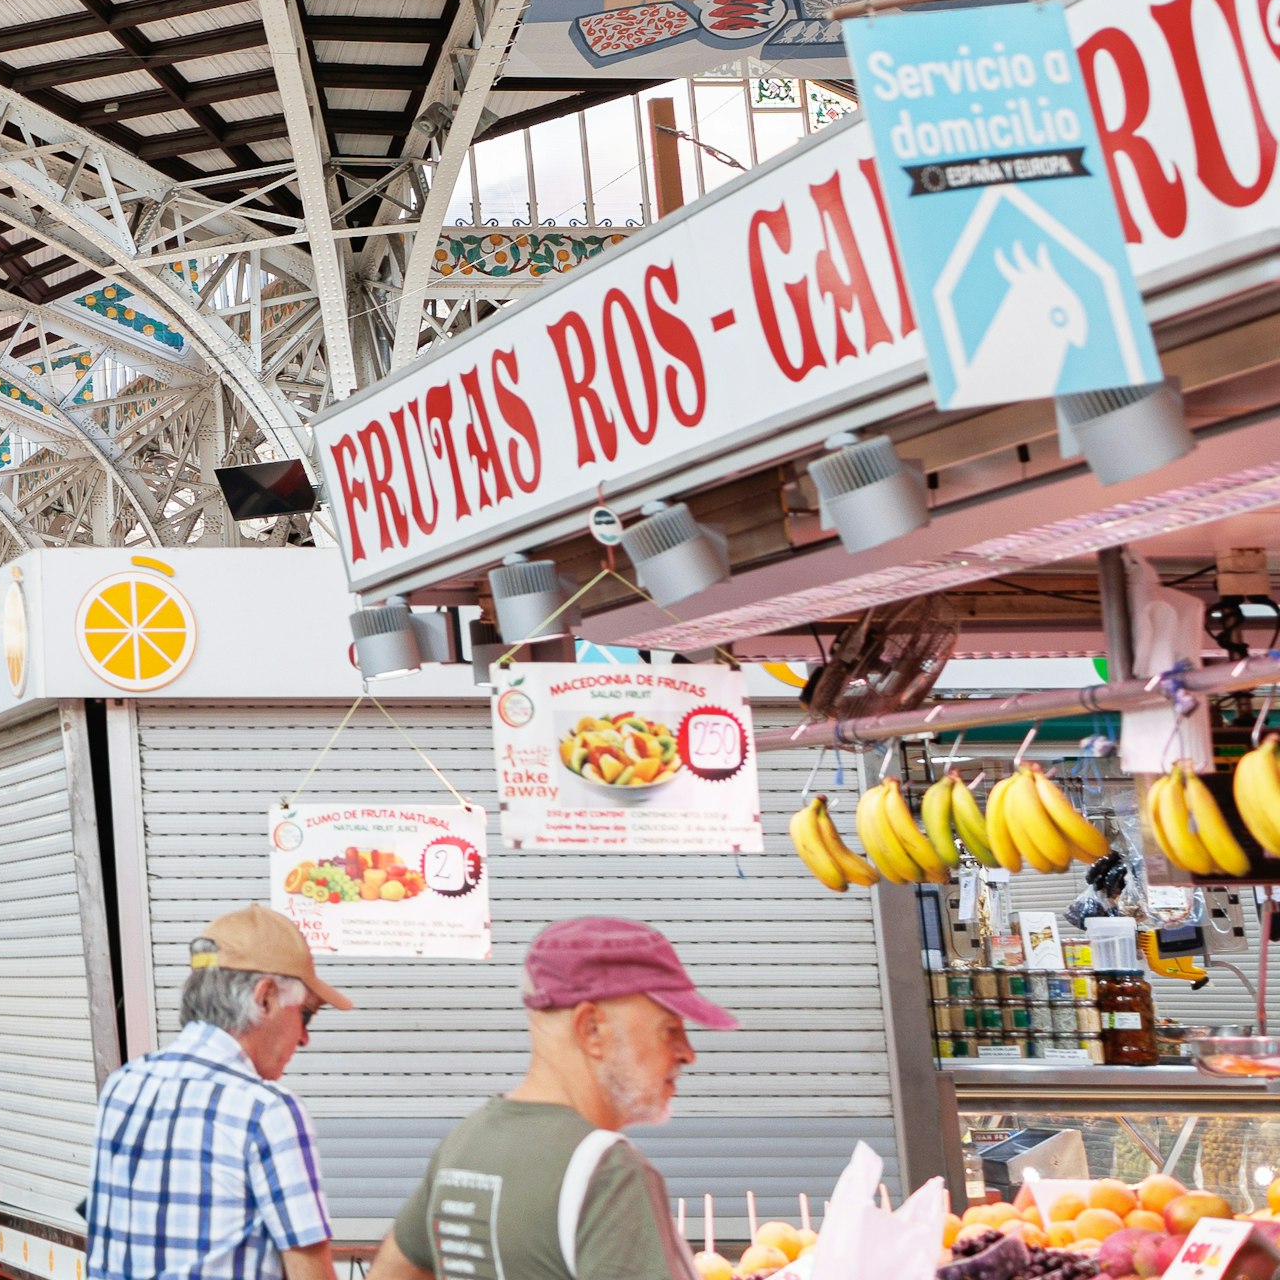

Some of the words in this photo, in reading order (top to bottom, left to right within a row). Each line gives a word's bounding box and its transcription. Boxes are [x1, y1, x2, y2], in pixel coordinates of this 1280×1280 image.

[867, 42, 1037, 101] Servicio
[1042, 49, 1071, 86] a
[890, 98, 1082, 160] domicilio
[944, 158, 1000, 188] ESPAÑA
[1001, 161, 1012, 181] Y
[1012, 154, 1074, 181] EUROPA
[330, 341, 541, 565] FRUTAS
[550, 674, 631, 697] MACEDONIA
[637, 674, 654, 686] DE
[657, 676, 707, 698] FRUTAS
[590, 690, 621, 699] SALAD
[626, 689, 651, 699] FRUIT
[503, 769, 549, 784] take
[504, 785, 559, 801] away
[306, 811, 340, 828] ZUMO
[344, 809, 358, 820] DE
[361, 808, 396, 820] FRUTA
[400, 811, 451, 830] NATURAL
[333, 824, 369, 832] NATURAL
[372, 824, 396, 832] FRUIT
[397, 824, 419, 833] JUICE
[433, 849, 451, 880] 2
[462, 846, 478, 886] €
[294, 919, 323, 930] ake
